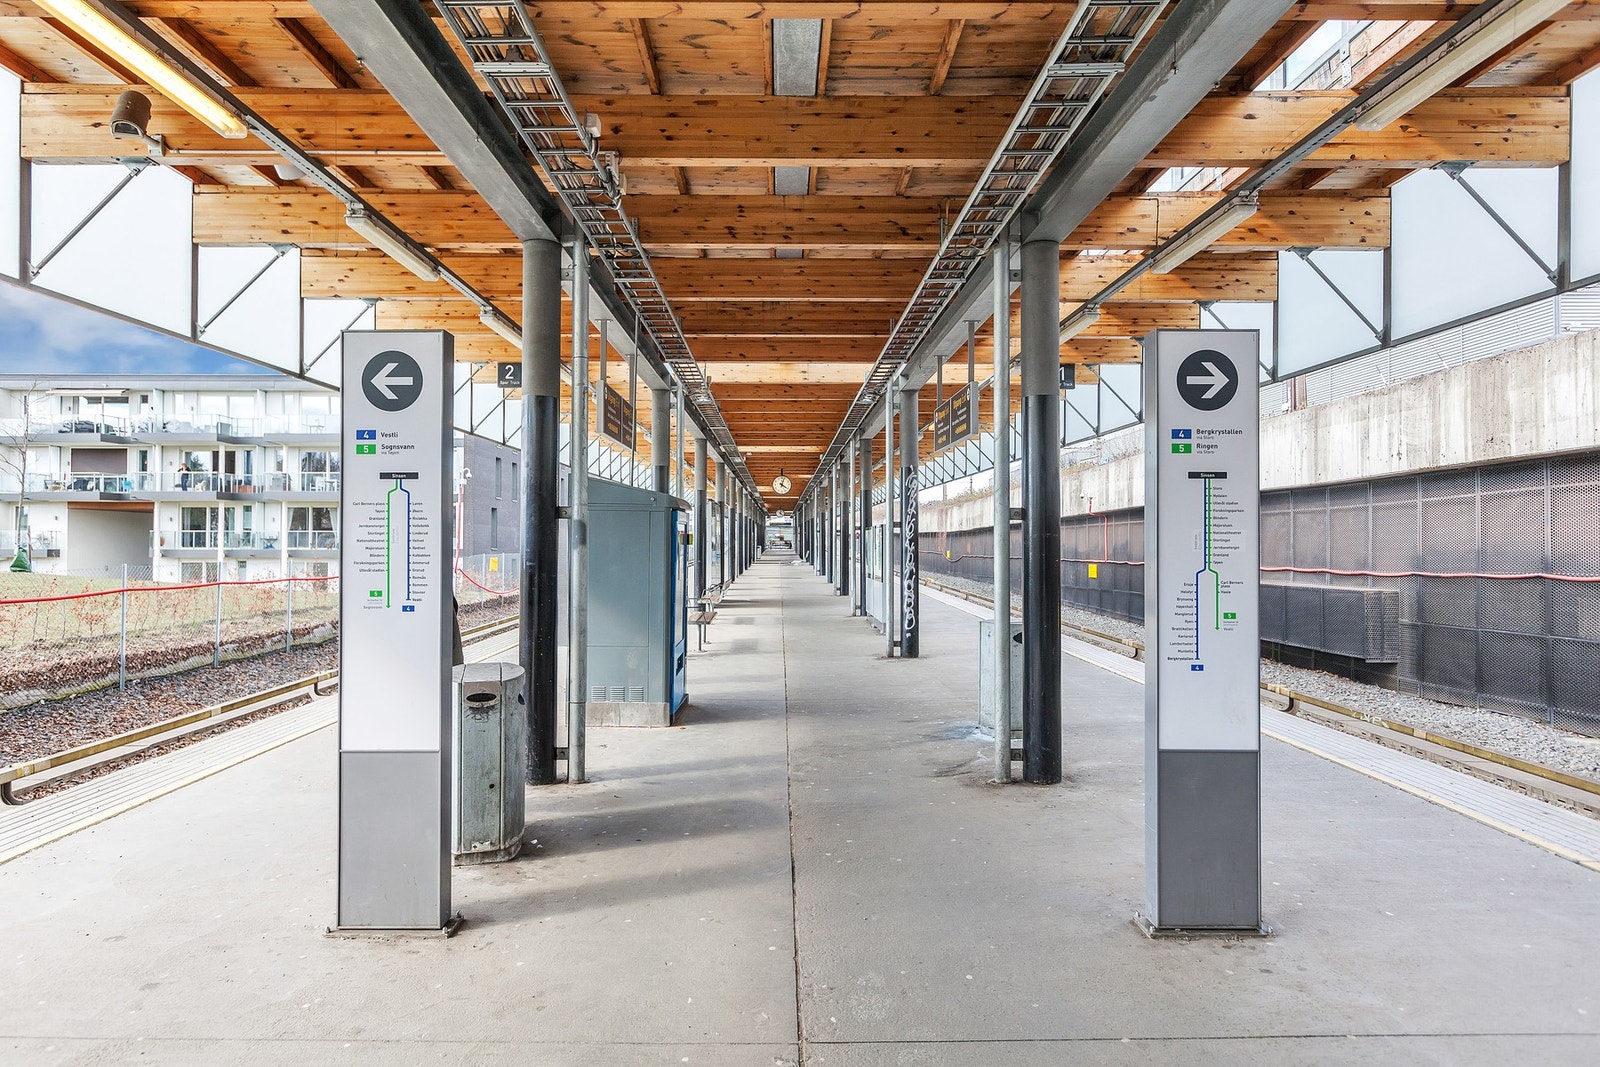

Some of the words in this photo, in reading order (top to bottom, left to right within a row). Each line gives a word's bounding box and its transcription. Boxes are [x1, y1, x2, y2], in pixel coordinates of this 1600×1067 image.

[505, 364, 514, 380] 2
[1059, 366, 1065, 380] 1
[363, 431, 369, 439] 4
